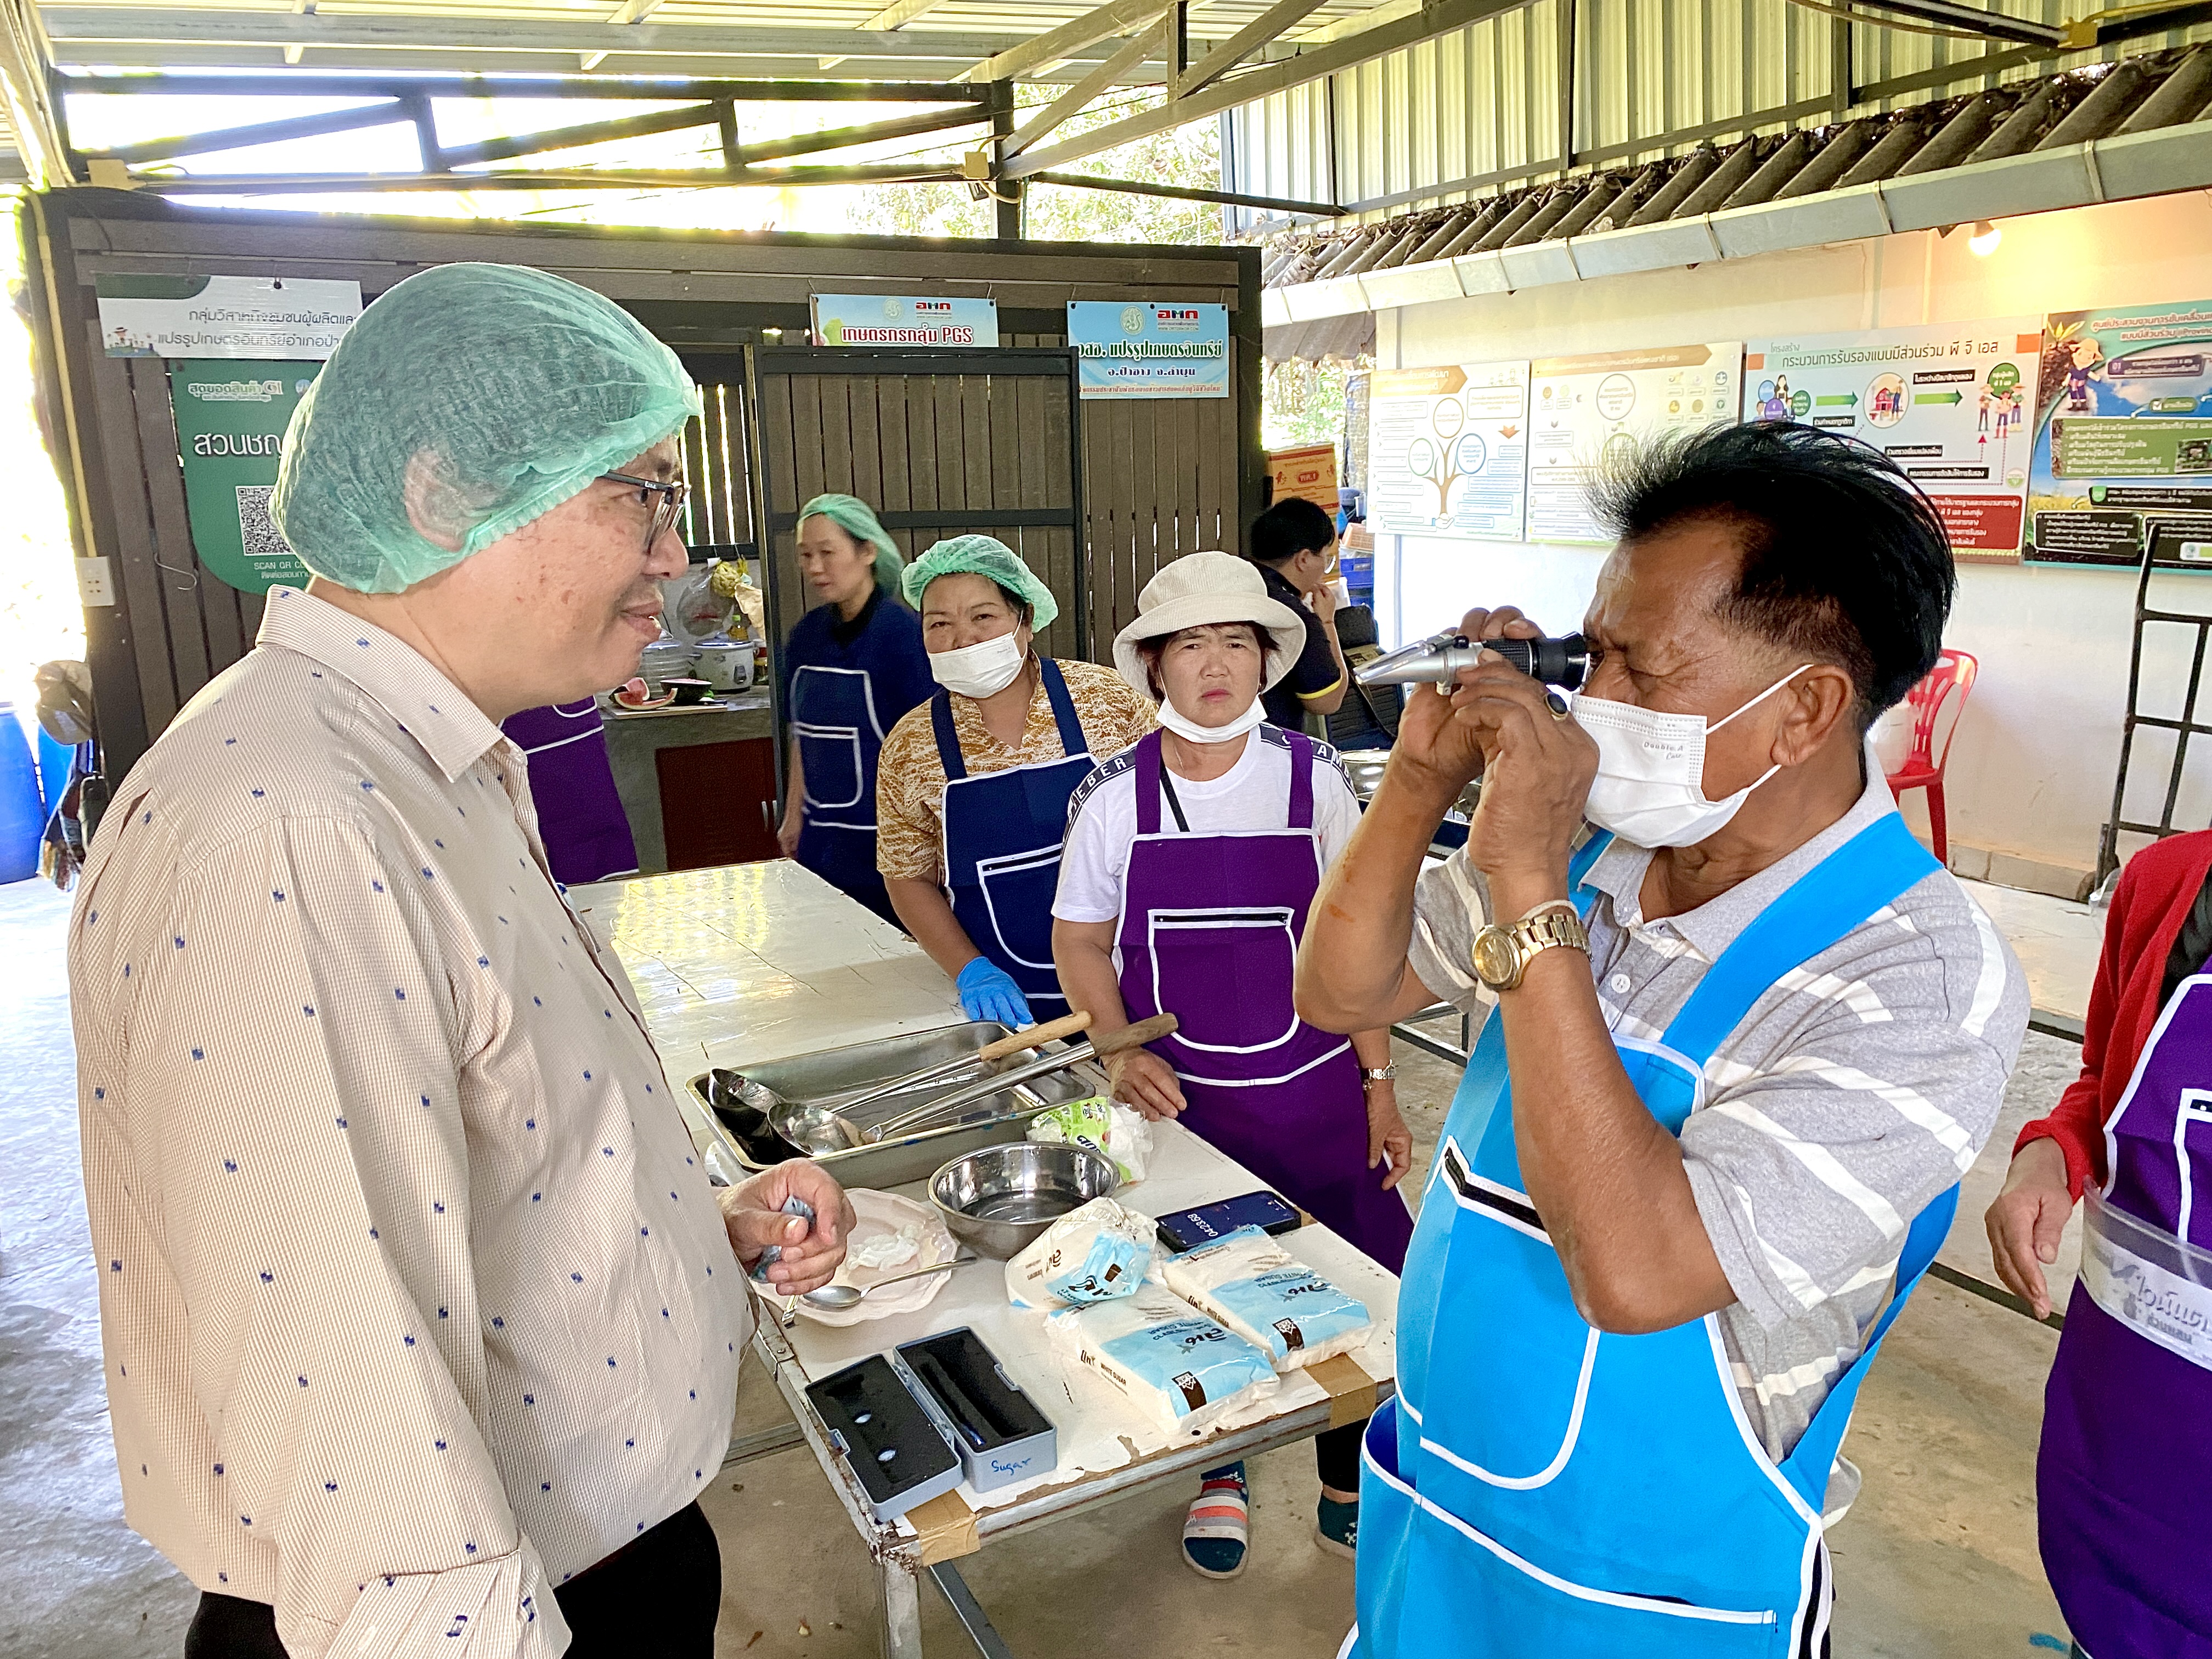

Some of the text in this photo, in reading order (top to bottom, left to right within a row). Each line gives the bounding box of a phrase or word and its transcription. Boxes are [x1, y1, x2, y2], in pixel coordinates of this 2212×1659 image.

[189, 308, 357, 326] กลุ่มวิสาหกิจชุมชนผู้ผลิตแล
[843, 324, 972, 344] เกษตรกรกลุ่ม PGS
[1110, 340, 1222, 360] แปรรูปเกษตรอินทรีย์
[1771, 342, 1800, 353] โครงสร้าง
[1783, 340, 1999, 368] กระบวนการรับรองแบบมีส่วนร่วม พี จี เอส
[1157, 366, 1195, 377] จ.ลำพูน
[254, 562, 275, 570] SCAN
[1644, 741, 1675, 751] Double
[991, 1457, 1032, 1476] Sugar
